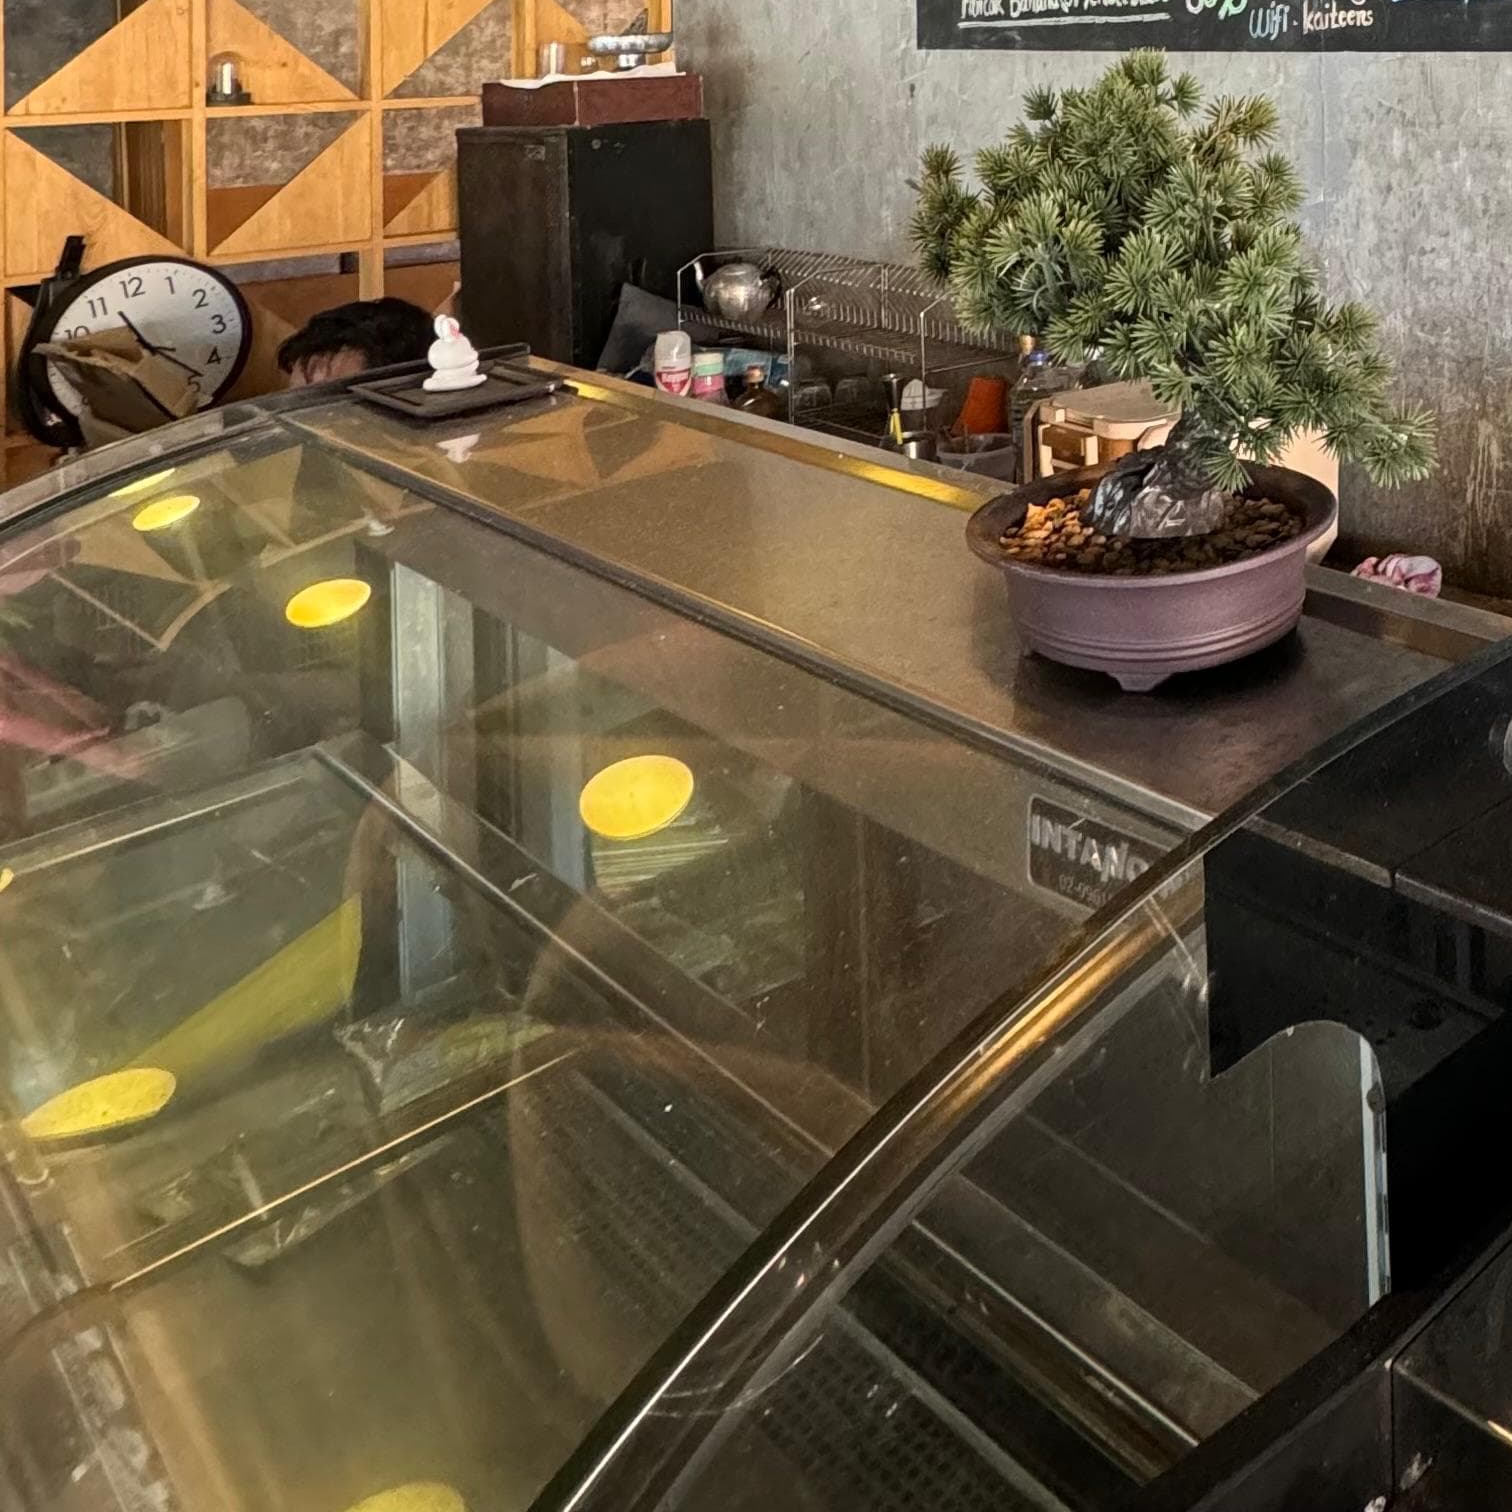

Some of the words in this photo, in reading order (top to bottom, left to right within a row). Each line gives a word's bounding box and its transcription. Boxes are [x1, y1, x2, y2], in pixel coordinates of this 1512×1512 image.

[120, 276, 146, 299] 12
[165, 275, 176, 295] 1
[87, 296, 109, 319] 11
[192, 289, 208, 309] 2
[210, 314, 227, 334] 3
[206, 347, 222, 365] 4
